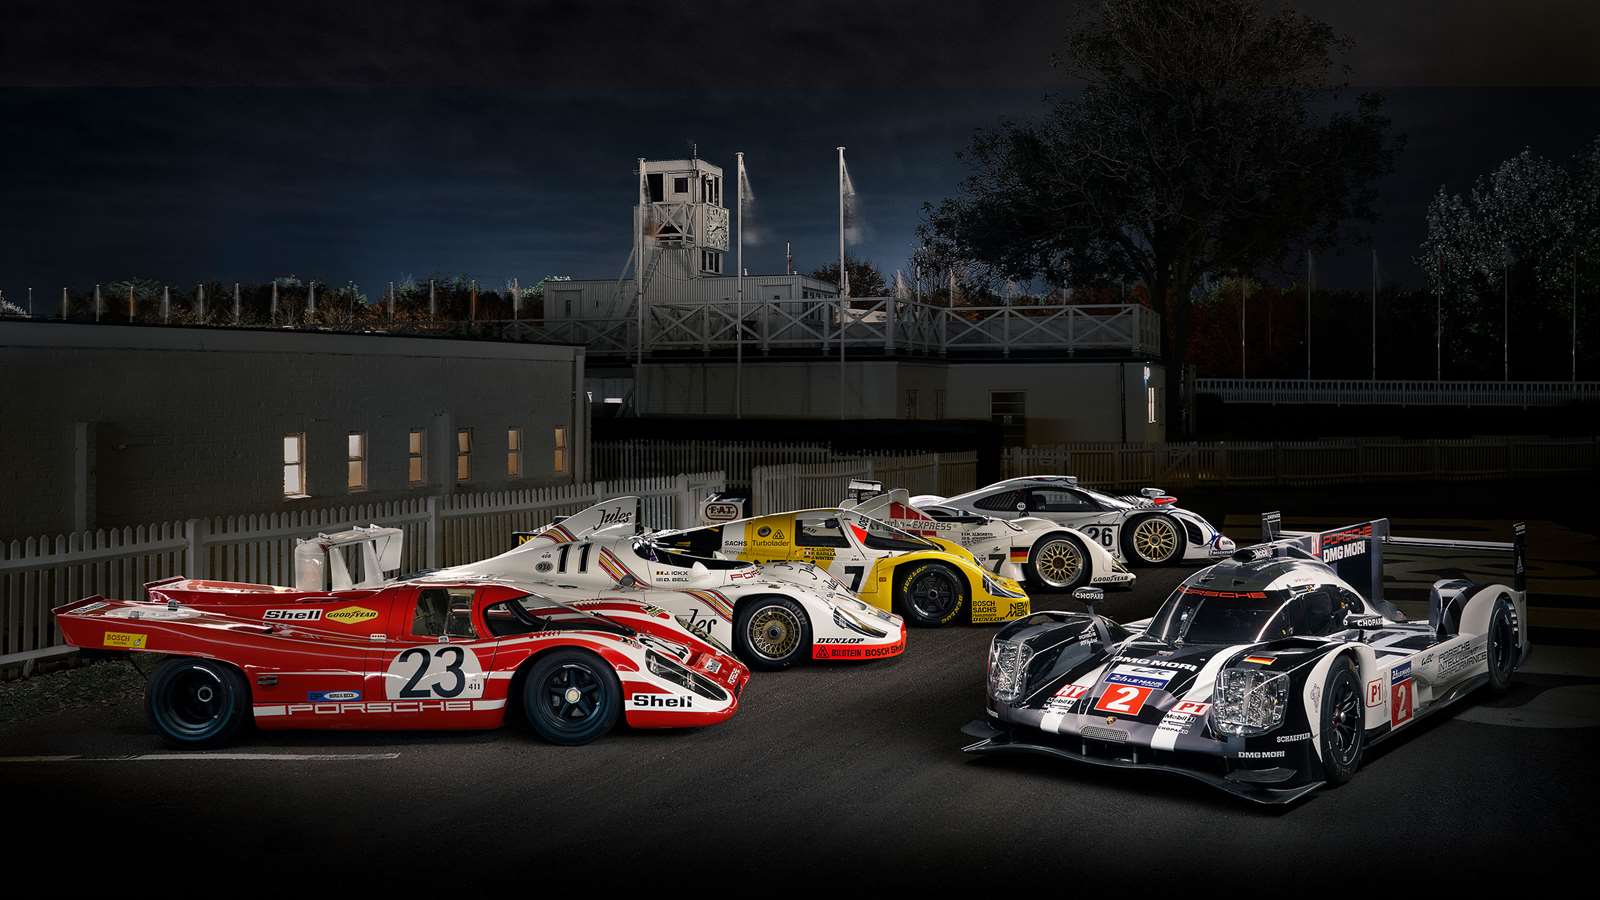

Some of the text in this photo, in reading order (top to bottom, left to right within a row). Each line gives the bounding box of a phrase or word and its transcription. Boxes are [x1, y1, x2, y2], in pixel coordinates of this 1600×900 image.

[593, 507, 633, 531] Jules
[1088, 527, 1112, 547] 26
[1322, 523, 1372, 546] PORSCHE
[557, 543, 592, 574] 11
[1323, 540, 1366, 563] DMG MORI
[989, 554, 1006, 573] 7
[845, 566, 864, 593] 7
[265, 610, 321, 619] Shell
[327, 610, 376, 619] GOODYEAR
[107, 634, 130, 642] BOSCH
[832, 649, 861, 657] BILSTEIN
[865, 648, 889, 657] BOSCH
[398, 646, 466, 698] 23
[1111, 656, 1198, 672] DMG MORI
[1055, 684, 1087, 698] HY
[1105, 687, 1140, 711] 2
[1371, 683, 1381, 702] P1
[288, 701, 470, 716] PORSCHE
[634, 695, 693, 707] Shell
[1178, 703, 1206, 713] P1
[1397, 685, 1407, 720] 2
[1277, 732, 1311, 743] SCHAEFFLER
[1238, 750, 1286, 759] DMG MORI
